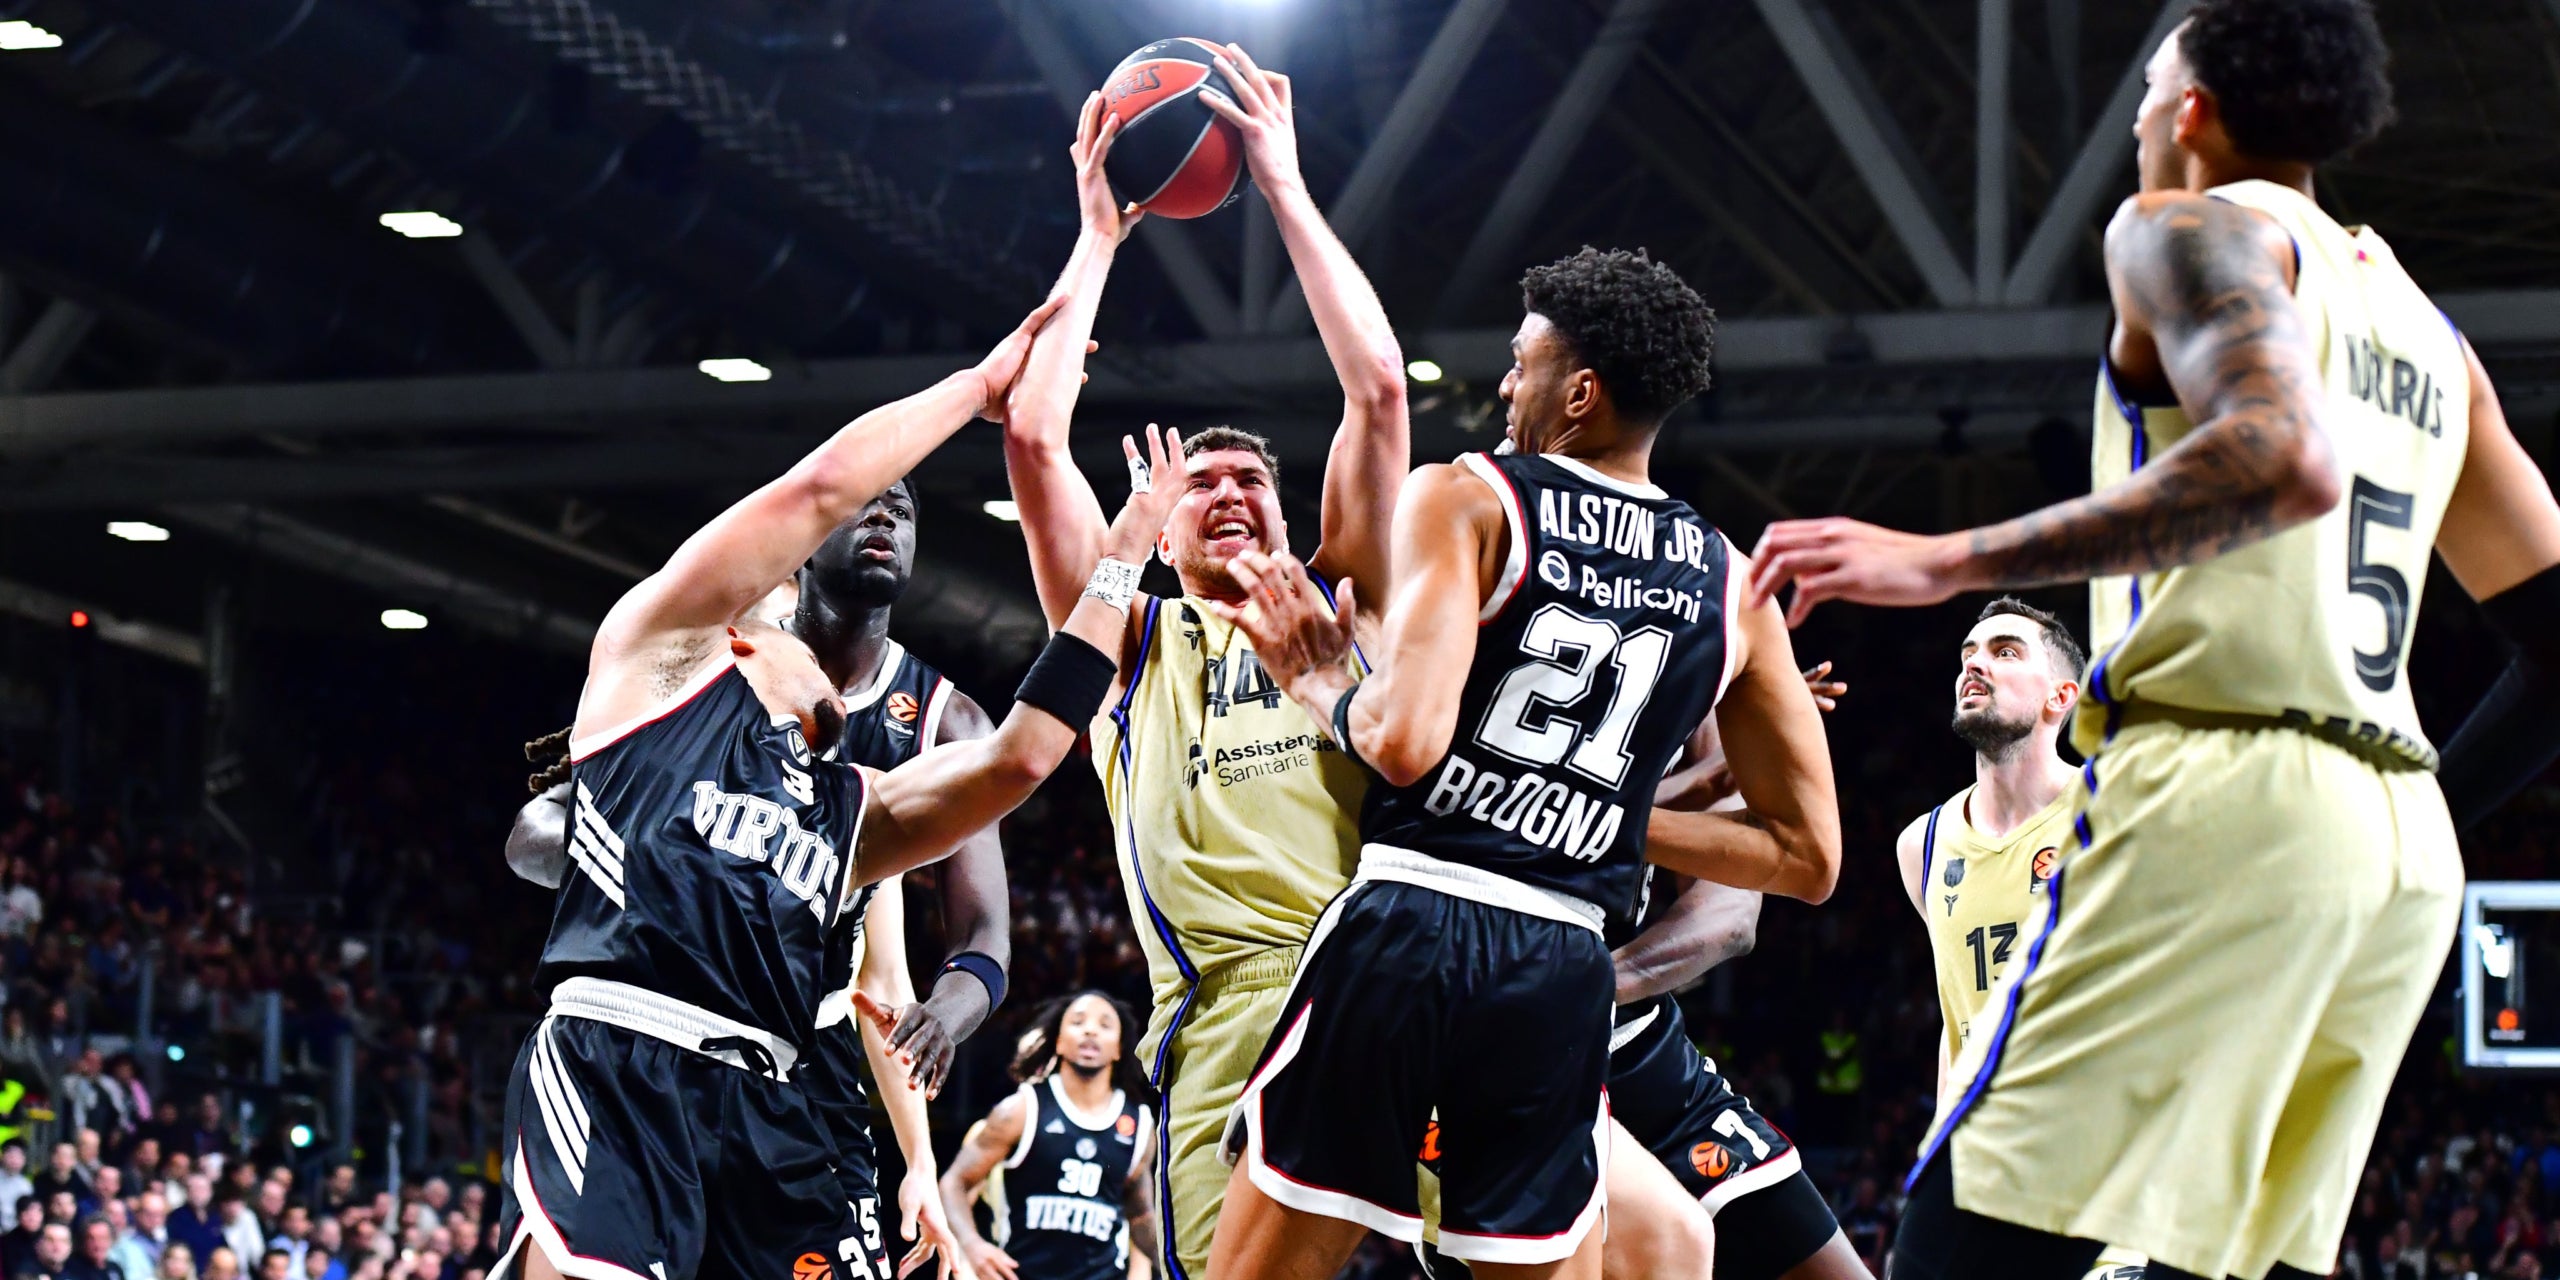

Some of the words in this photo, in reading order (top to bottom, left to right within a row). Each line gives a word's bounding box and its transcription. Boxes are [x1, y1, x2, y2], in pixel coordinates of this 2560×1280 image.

[1540, 488, 1655, 561] ALSTON
[1665, 517, 1709, 574] JR.
[1579, 564, 1703, 624] Pelliconi
[2348, 473, 2414, 693] 5
[1472, 602, 1674, 792] 21
[1218, 752, 1310, 788] Sanitària
[1966, 921, 2018, 992] 13
[1057, 1158, 1103, 1198] 30
[1025, 1195, 1117, 1242] VIRTUS
